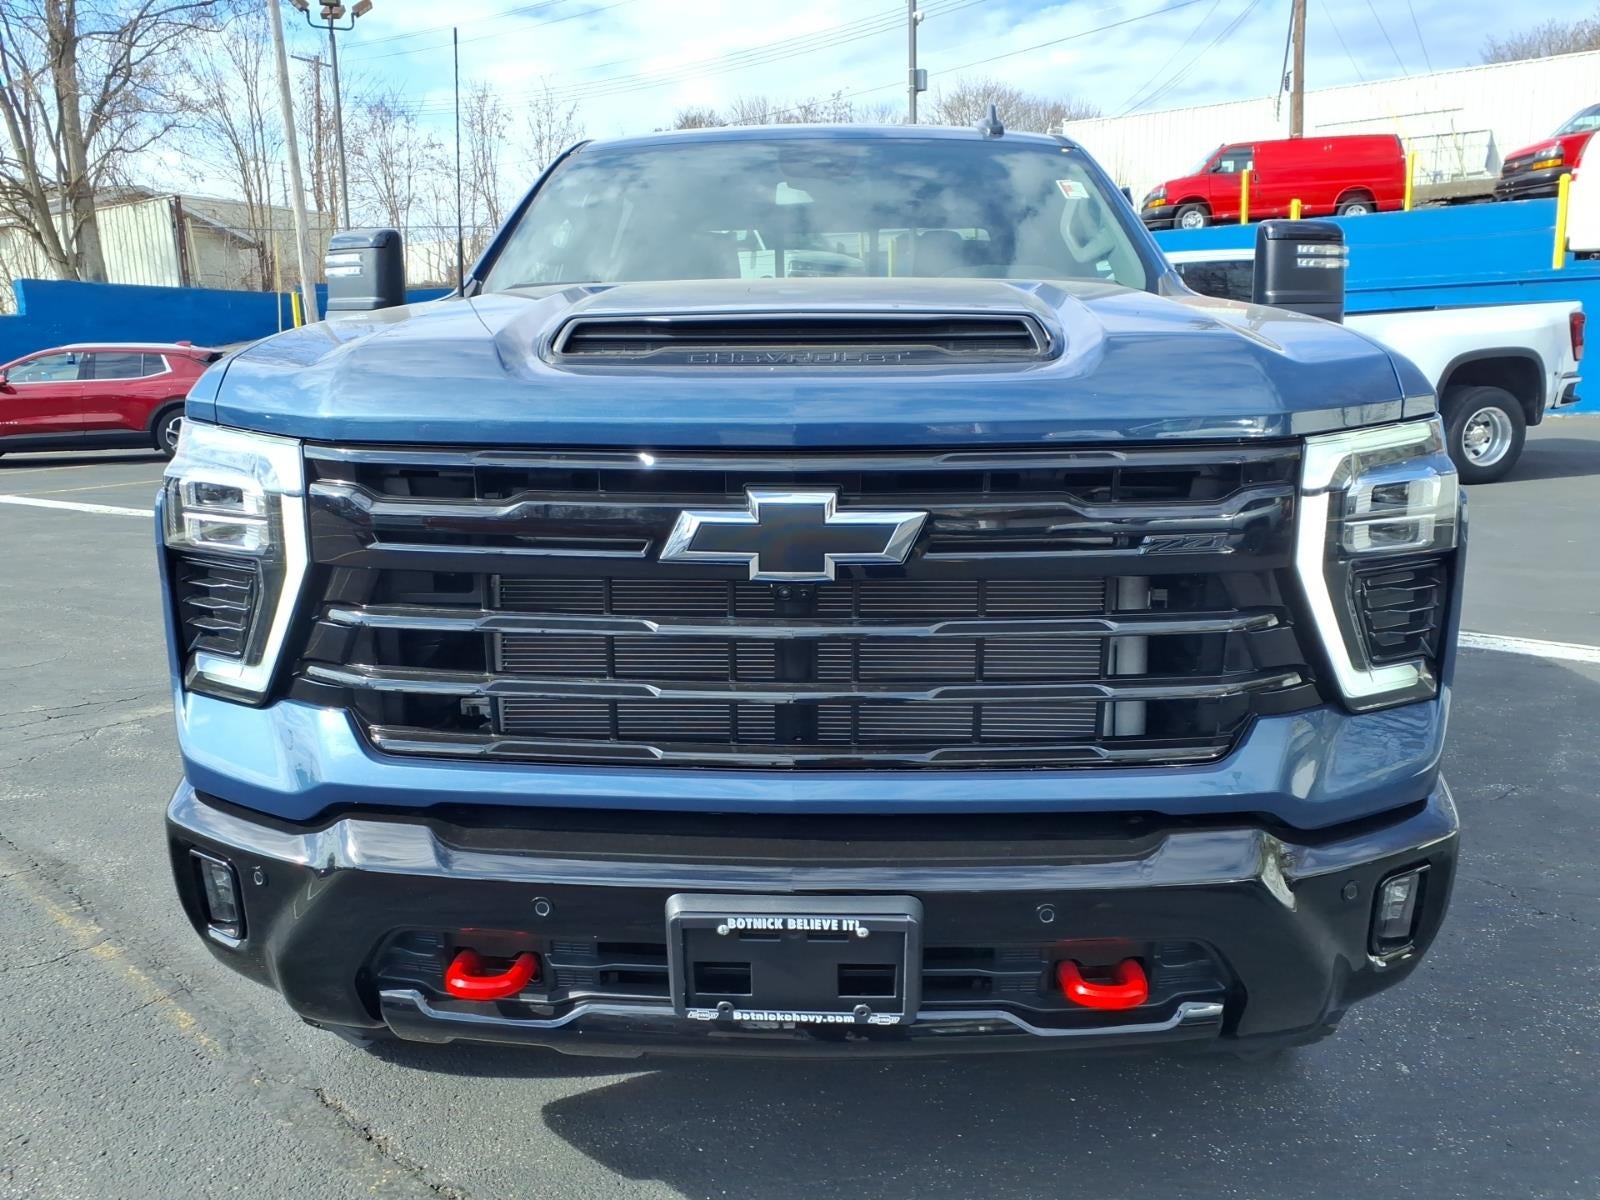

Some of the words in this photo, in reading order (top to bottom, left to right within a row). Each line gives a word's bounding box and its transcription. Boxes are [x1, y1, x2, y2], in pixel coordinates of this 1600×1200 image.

[688, 351, 911, 364] CHEVROLET
[1138, 533, 1233, 555] Z71
[727, 917, 783, 930] BOTNICK
[788, 918, 838, 931] BELIEVE
[733, 1011, 855, 1024] Botnickchevy.com
